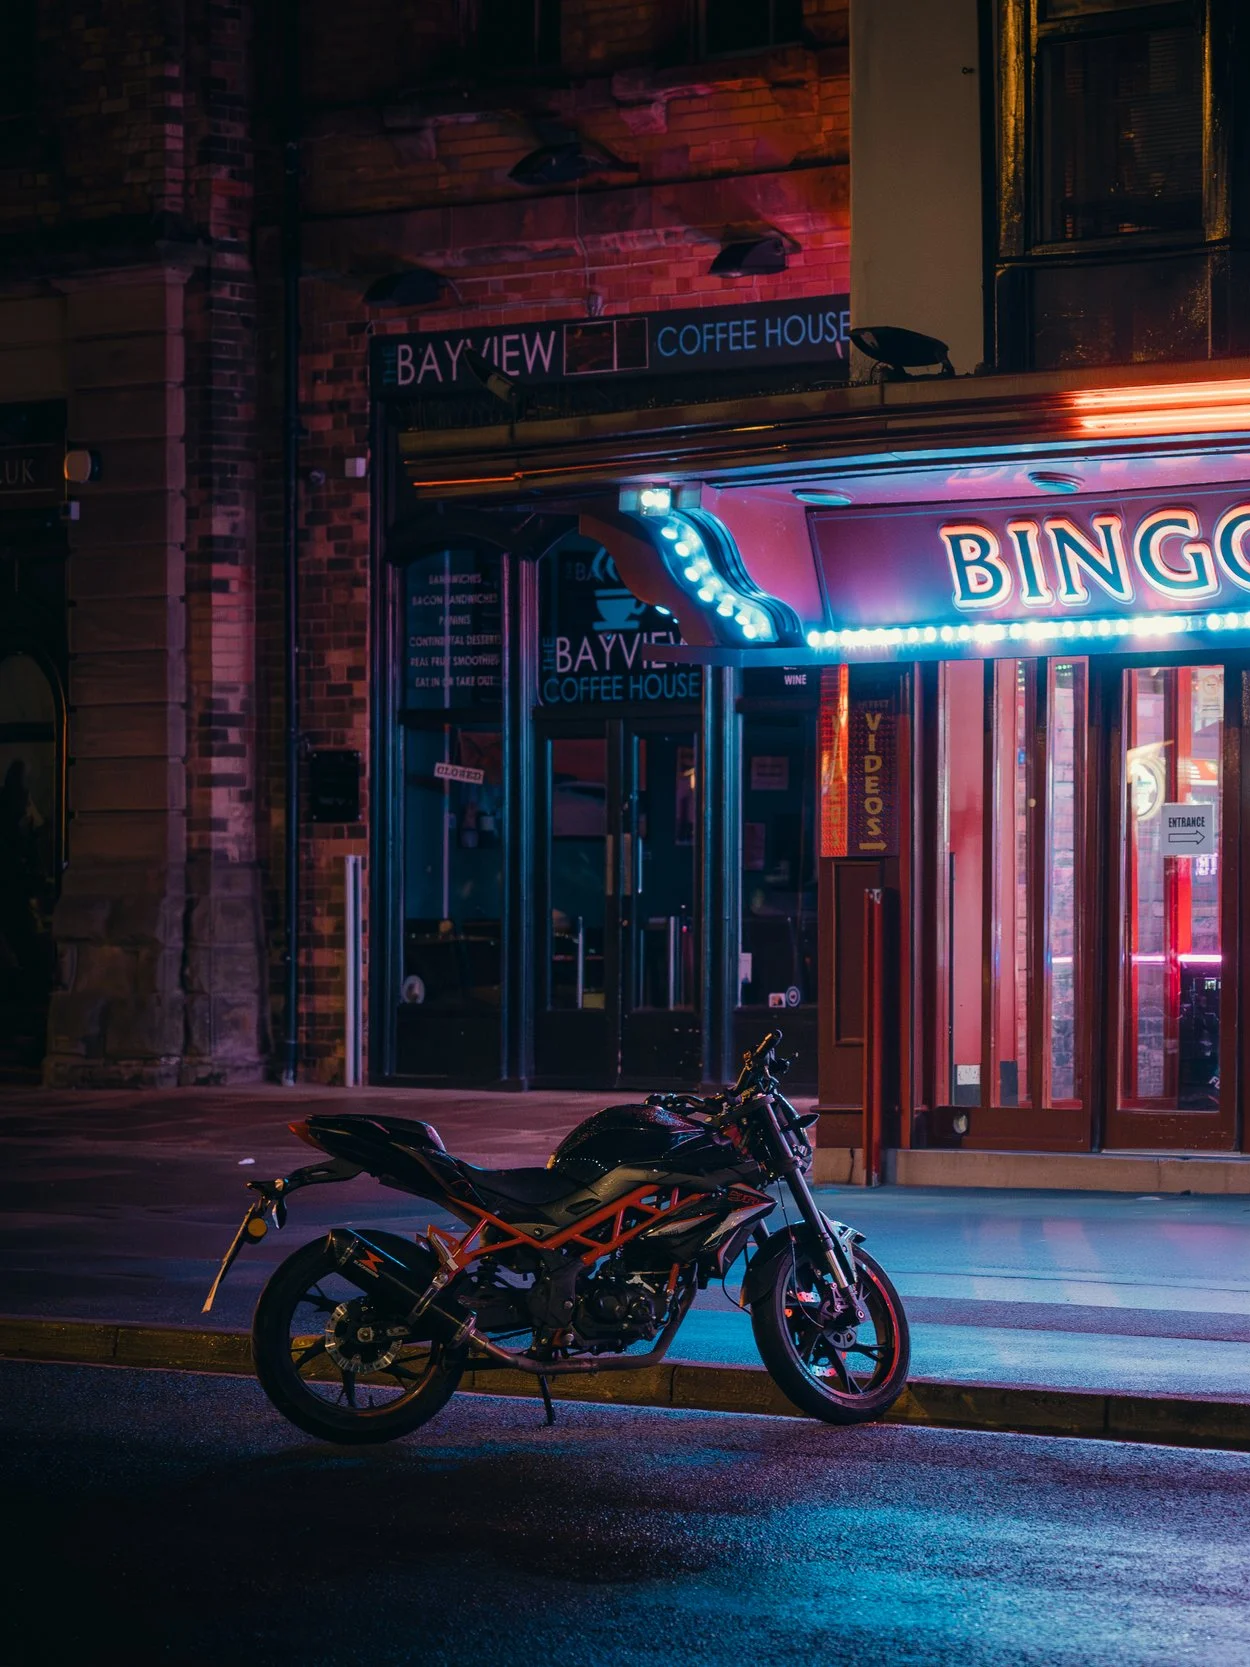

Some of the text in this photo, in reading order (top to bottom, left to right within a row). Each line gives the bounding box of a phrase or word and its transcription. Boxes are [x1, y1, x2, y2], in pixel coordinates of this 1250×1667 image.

[657, 320, 757, 357] COFFEE
[764, 311, 850, 347] HOUSE
[429, 574, 482, 584] SANWICHES
[445, 593, 498, 605] ANDWICHES
[409, 636, 464, 647] CONTINETAL
[431, 656, 451, 667] FRU
[784, 674, 807, 686] WINE
[543, 673, 701, 704] COFFEE HOUSE
[437, 765, 482, 780] CLOSED
[864, 712, 883, 836] VIDEOS
[1168, 816, 1206, 828] ENTRANCE
